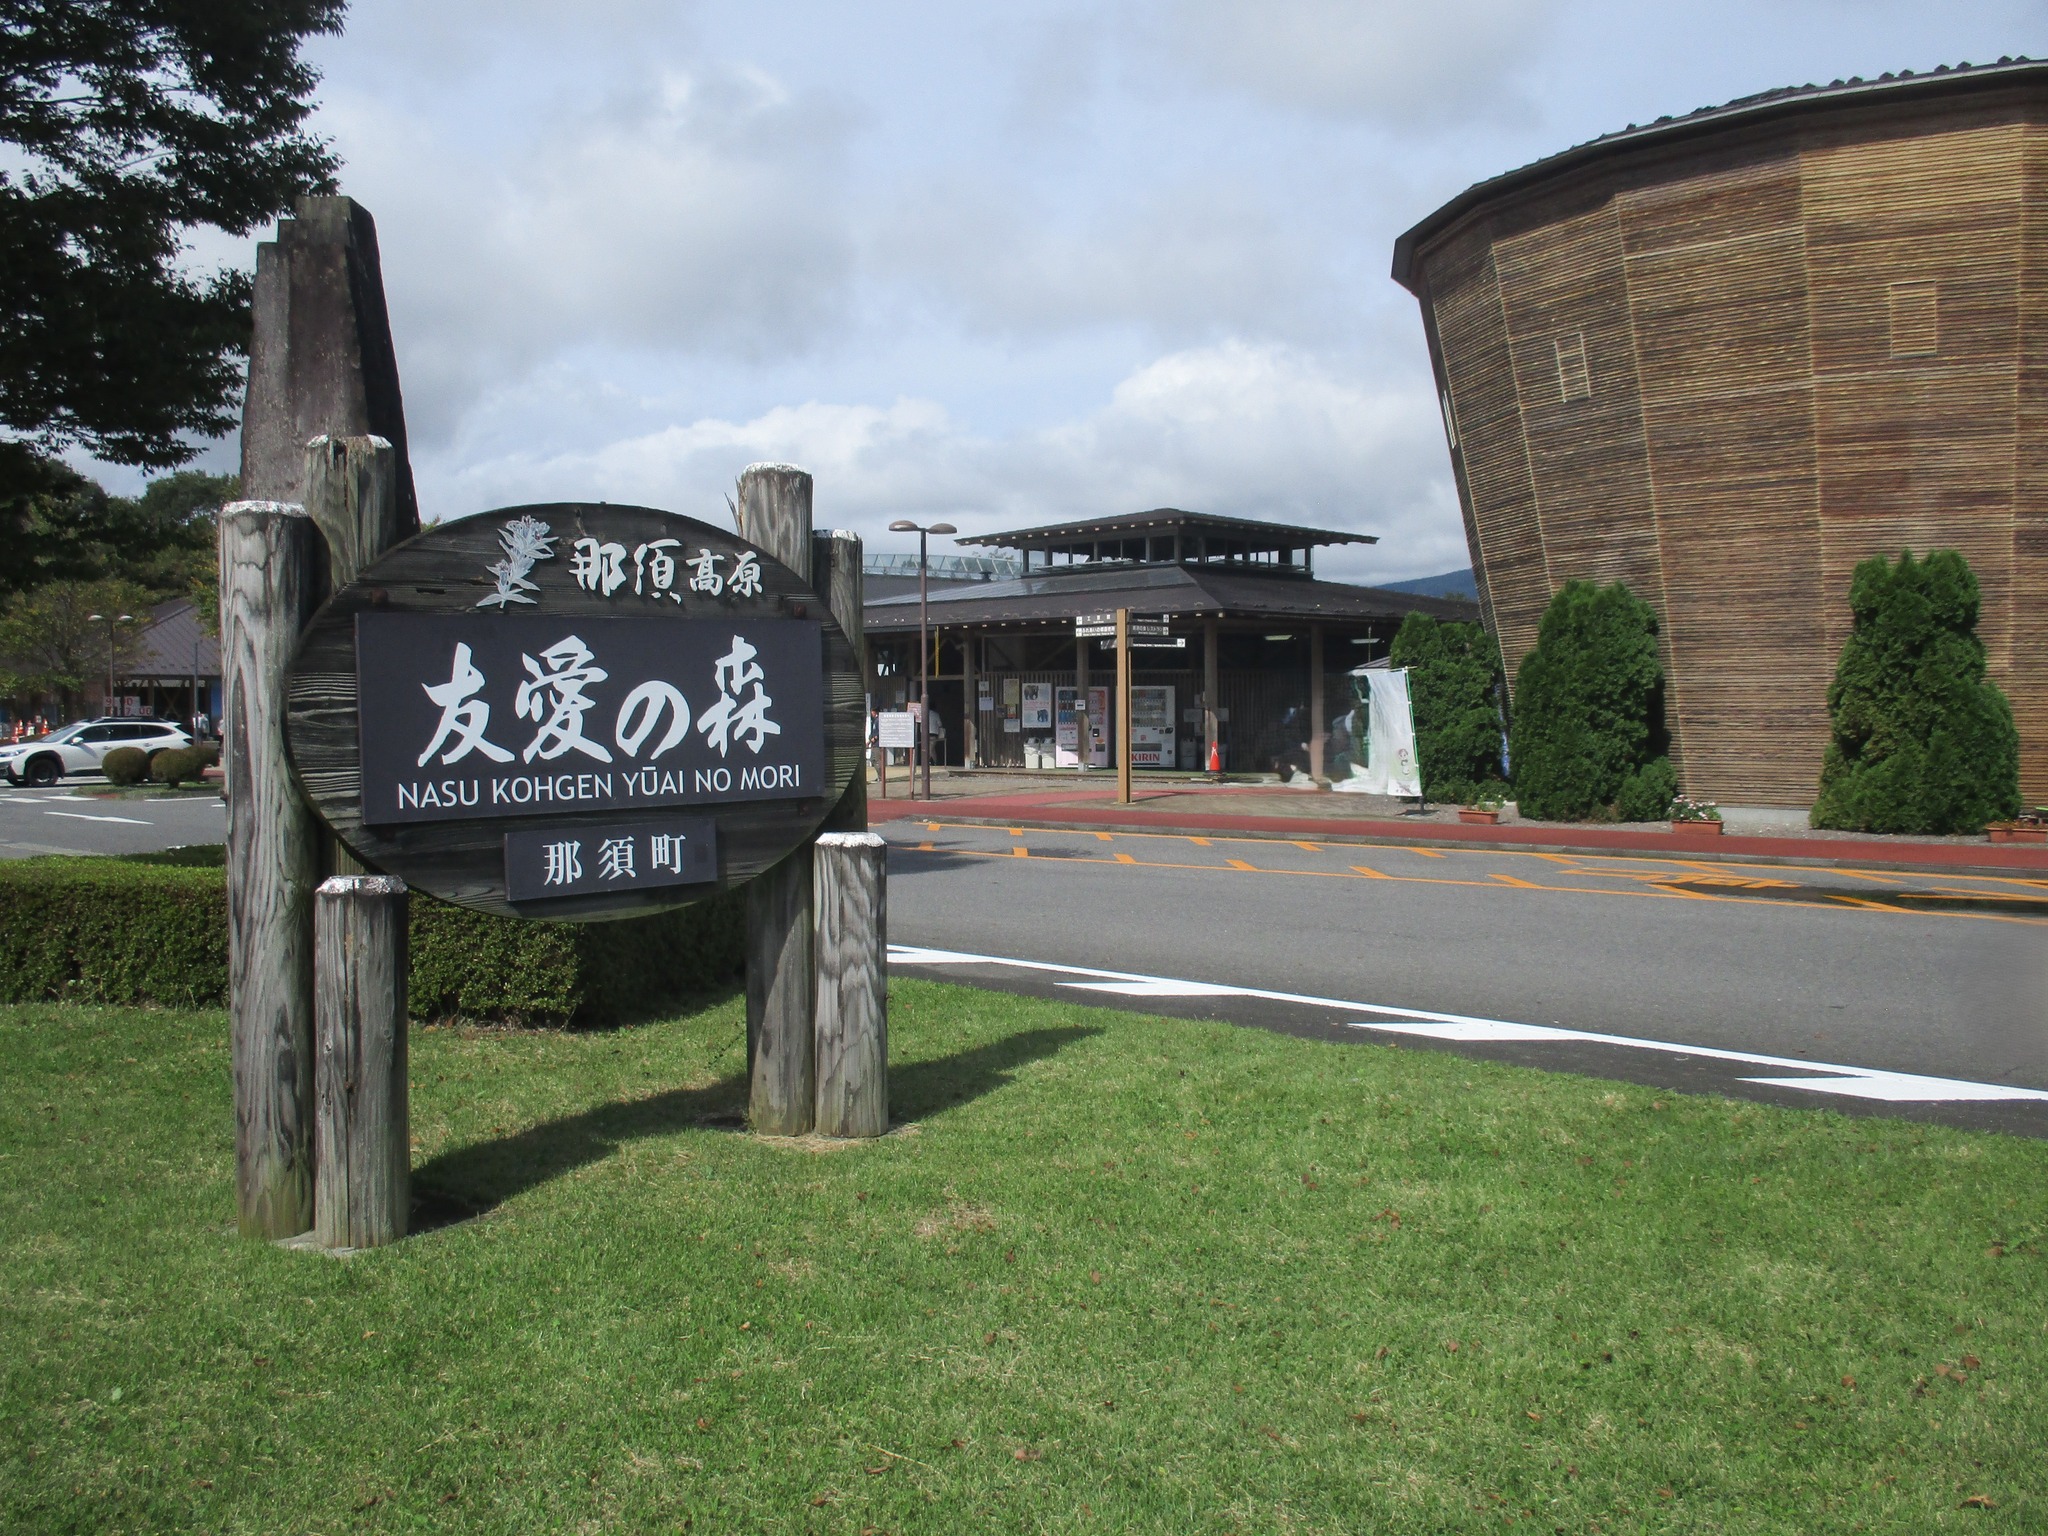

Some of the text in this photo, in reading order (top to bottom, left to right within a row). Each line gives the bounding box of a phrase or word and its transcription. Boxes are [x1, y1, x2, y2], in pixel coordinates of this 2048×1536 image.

[417, 634, 781, 767] 友愛の森
[1131, 753, 1160, 761] KIRIN
[398, 764, 800, 809] NASU KOHGEN YŪAI NO MORI
[542, 833, 686, 886] 那須町
